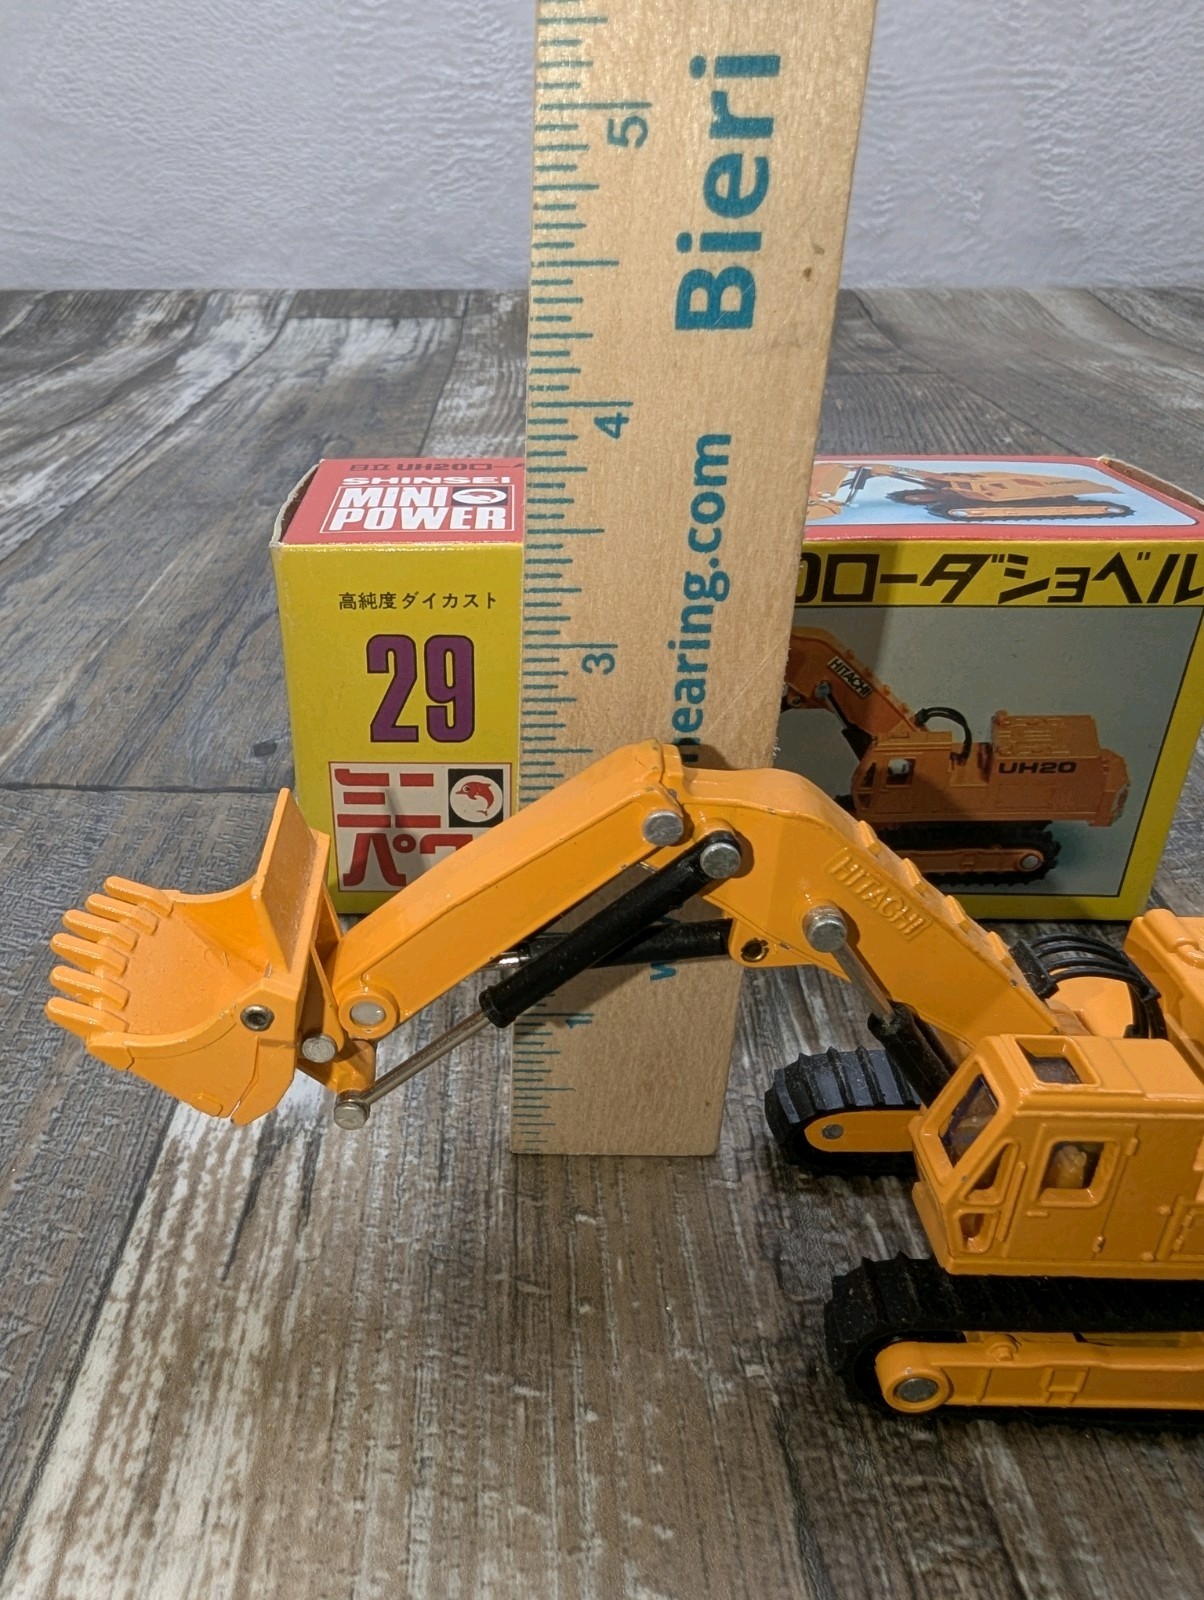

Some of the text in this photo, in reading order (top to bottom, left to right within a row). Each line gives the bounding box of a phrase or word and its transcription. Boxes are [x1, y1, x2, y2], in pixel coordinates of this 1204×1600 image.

[606, 115, 649, 149] 5
[675, 54, 781, 330] Bieri
[593, 412, 630, 439] 4
[342, 476, 511, 485] SHINSEI
[338, 486, 449, 508] MINI
[328, 507, 506, 531] POWER
[338, 591, 497, 610] 高純度ダイカスト
[581, 652, 616, 675] 3
[366, 634, 475, 743] 29
[830, 658, 872, 697] HITACHI
[998, 761, 1077, 774] UH20
[334, 768, 442, 828] ミニ
[827, 855, 926, 936] HITACHI
[564, 1018, 593, 1029] 1
